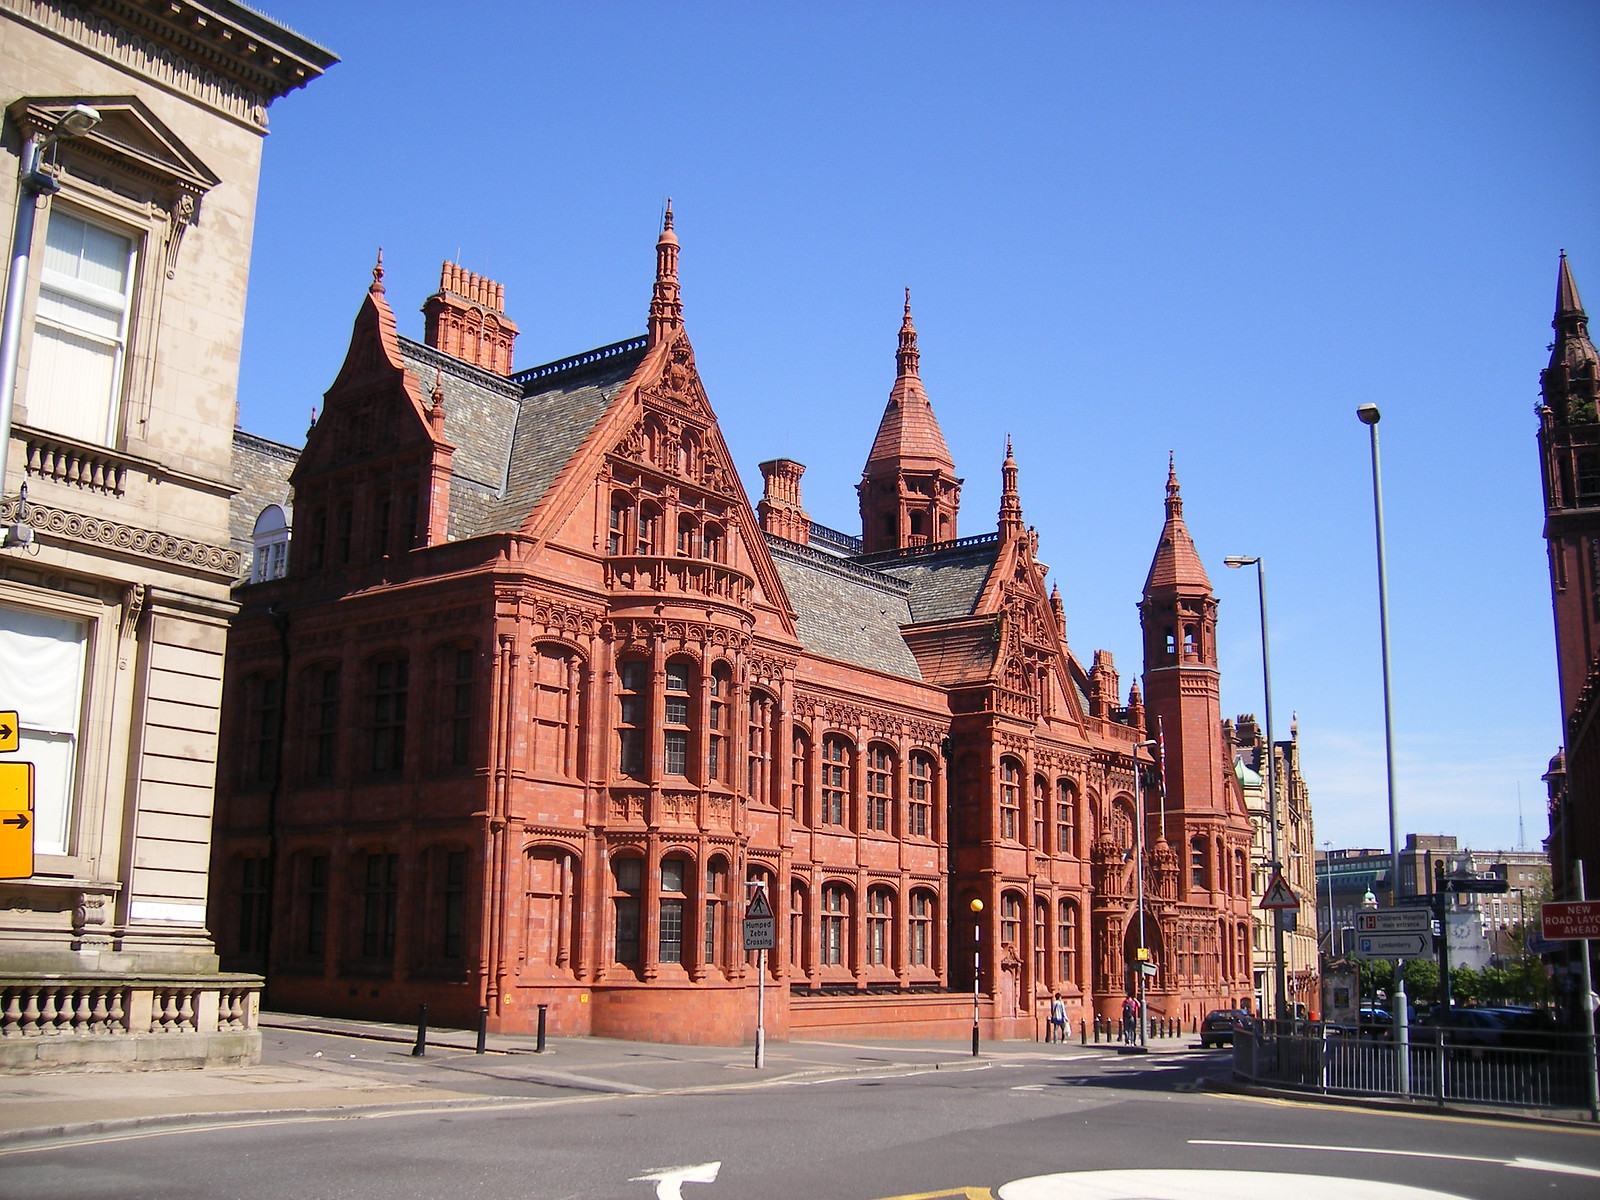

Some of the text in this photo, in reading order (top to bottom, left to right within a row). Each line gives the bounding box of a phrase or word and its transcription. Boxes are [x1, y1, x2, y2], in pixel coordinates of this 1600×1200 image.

[1568, 906, 1591, 914] NEW
[1402, 913, 1425, 921] Hospital
[1545, 916, 1573, 925] ROAD
[746, 921, 771, 929] Humped
[1564, 925, 1599, 934] AHEAD
[746, 938, 772, 946] Crossing
